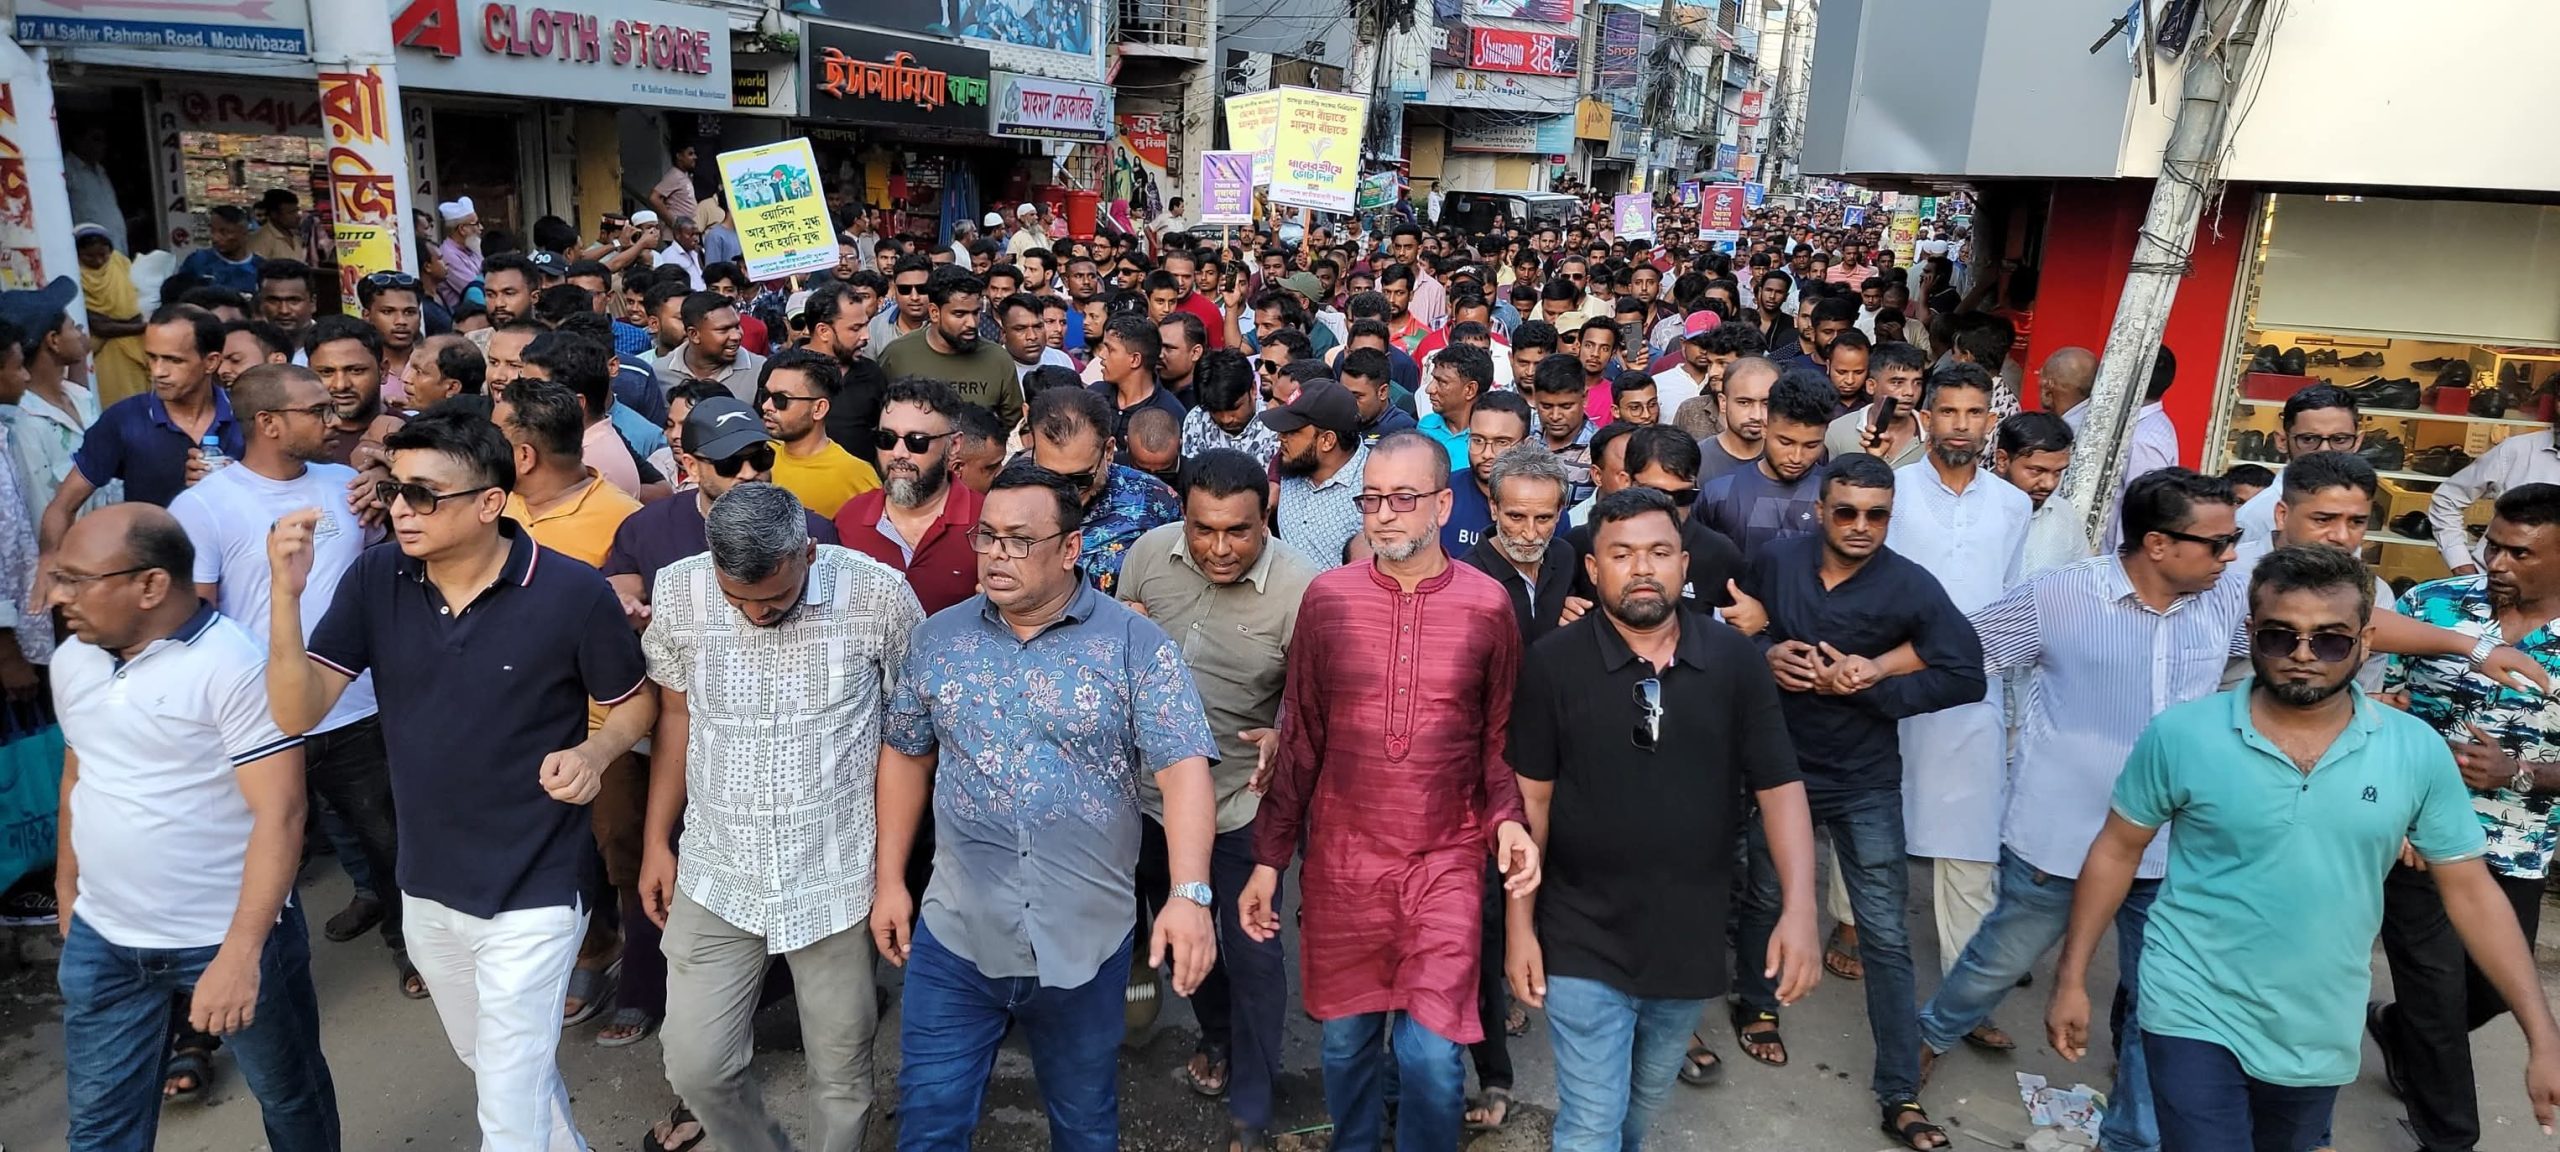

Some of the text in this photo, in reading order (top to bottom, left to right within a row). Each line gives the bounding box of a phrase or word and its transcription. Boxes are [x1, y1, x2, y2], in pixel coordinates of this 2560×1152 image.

[103, 26, 161, 44] Rahman
[211, 32, 301, 52] Moulvibazar
[482, 3, 599, 62] CLOTH
[612, 19, 712, 73] STORE
[1475, 31, 1524, 68] Shwapno
[820, 47, 946, 112] ইসলামিয়া
[738, 91, 766, 105] world
[759, 205, 796, 221] ওয়াসিম
[337, 231, 376, 240] OTTO
[745, 226, 768, 239] আবু
[754, 239, 774, 253] শেষ
[776, 232, 801, 248] হয়নি
